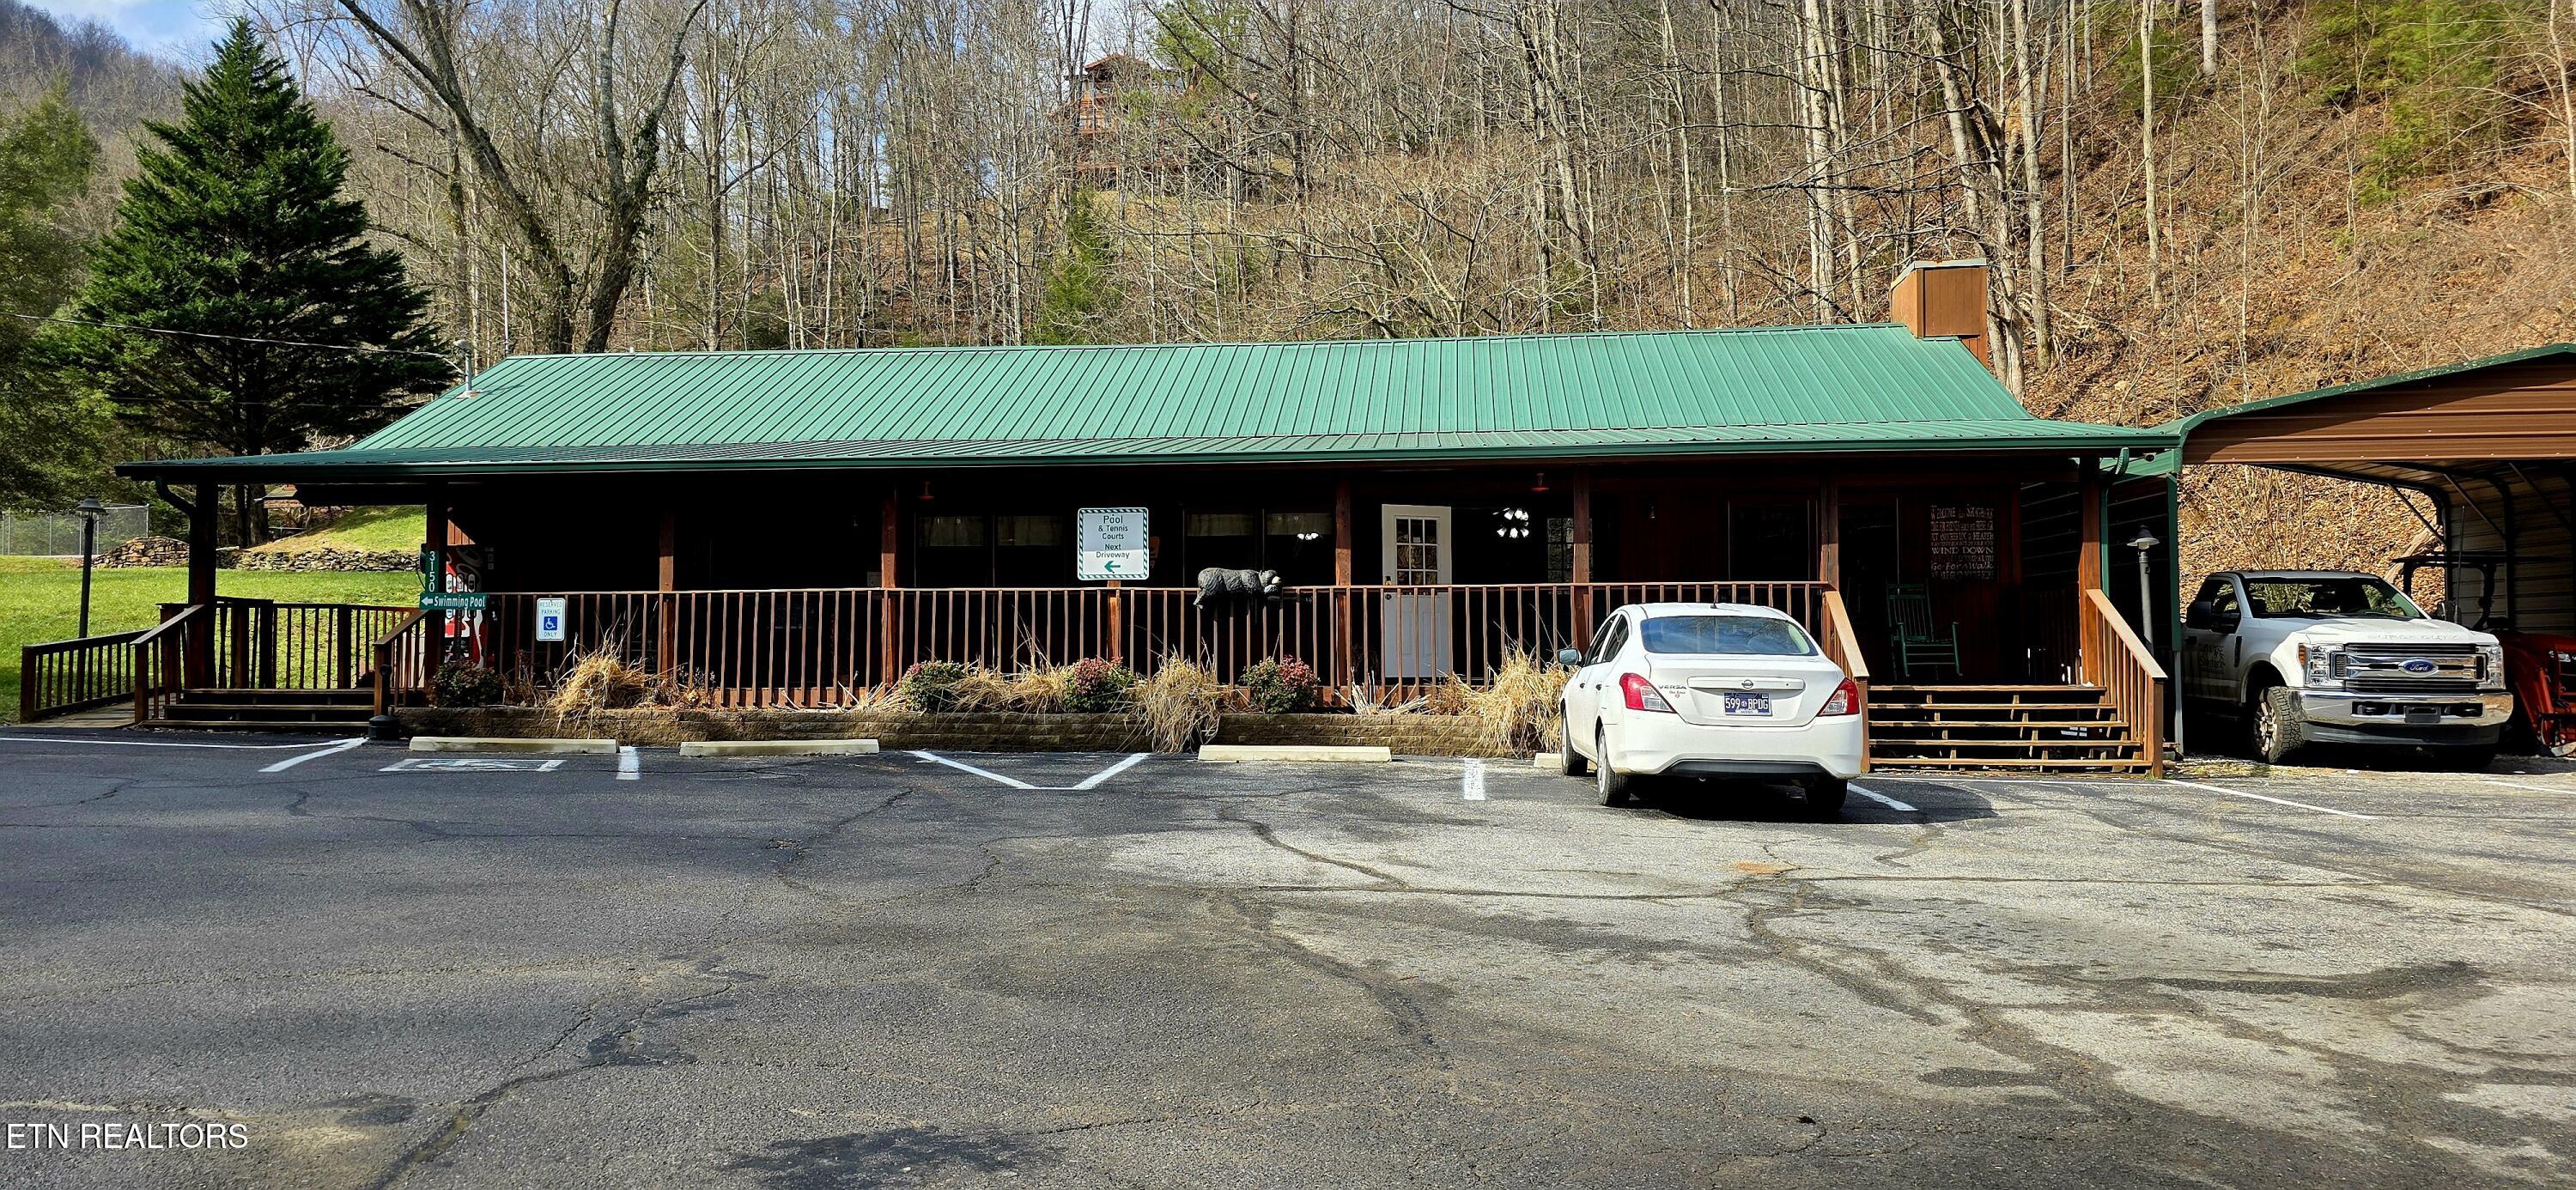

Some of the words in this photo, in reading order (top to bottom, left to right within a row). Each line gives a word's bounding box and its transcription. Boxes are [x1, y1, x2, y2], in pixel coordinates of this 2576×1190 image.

[1103, 515, 1123, 524] Pool
[1962, 546, 1994, 555] DOWN
[434, 594, 469, 610] Swimming
[470, 596, 486, 608] Pool
[2409, 663, 2429, 671] Ford
[1725, 697, 1741, 709] 599
